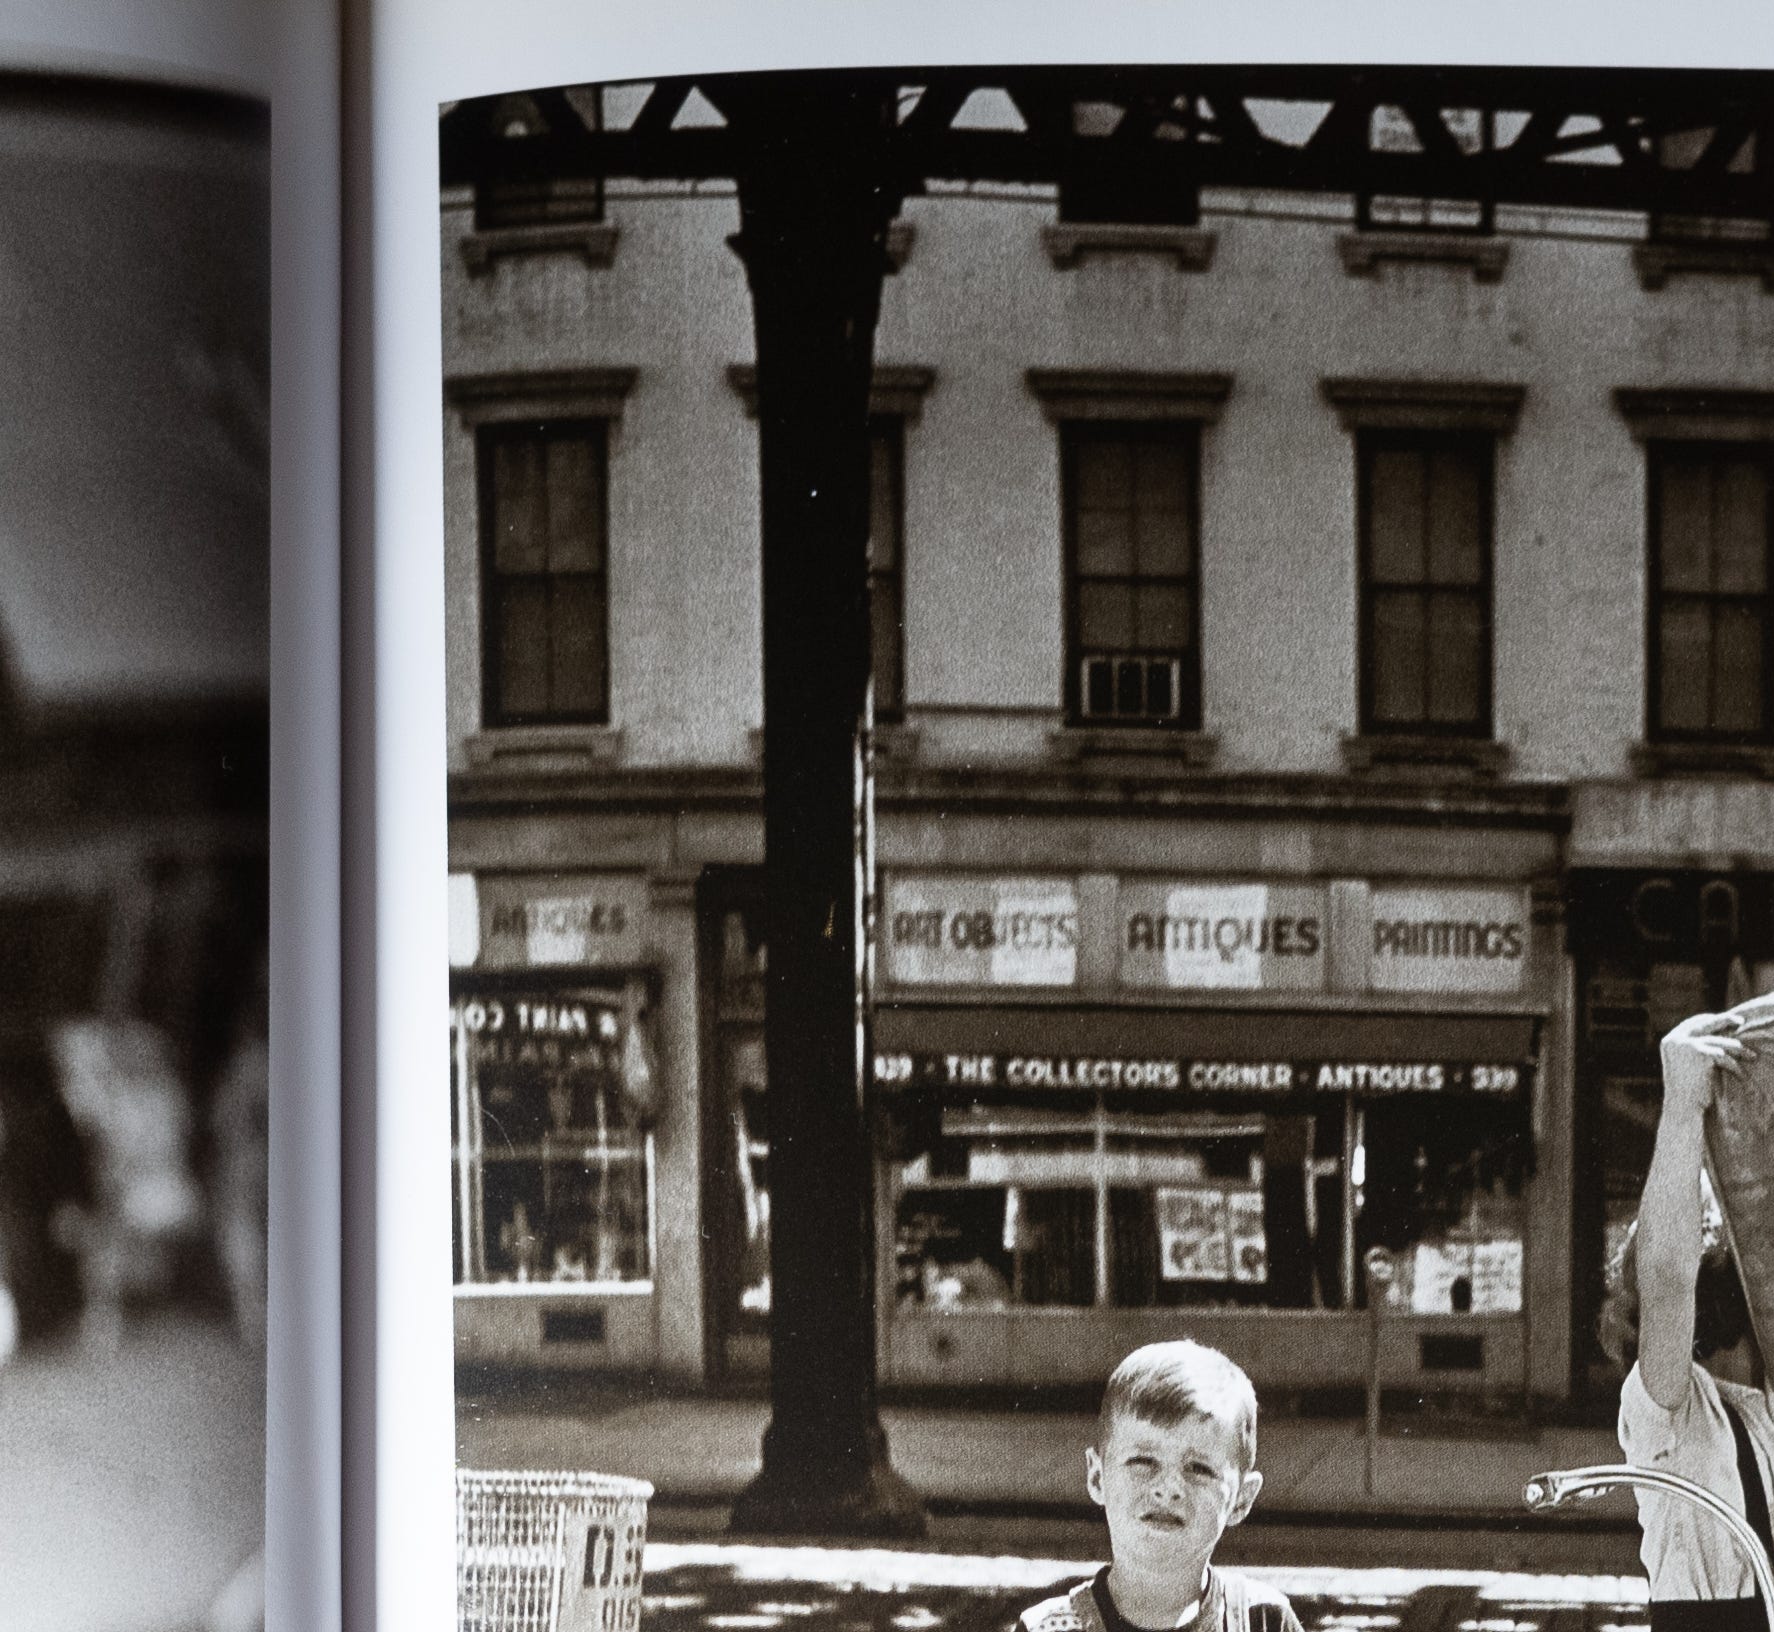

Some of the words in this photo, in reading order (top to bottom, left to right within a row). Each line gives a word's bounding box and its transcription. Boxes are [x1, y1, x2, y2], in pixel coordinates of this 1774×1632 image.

[950, 911, 1081, 950] OBJECTS
[1126, 912, 1320, 963] ANTIQUES
[1373, 918, 1523, 960] PAINTINGS
[946, 1055, 994, 1085] THE
[1006, 1057, 1180, 1089] COLLECTORS
[1188, 1063, 1293, 1090] CORNER
[1316, 1064, 1445, 1091] ANTIQUES
